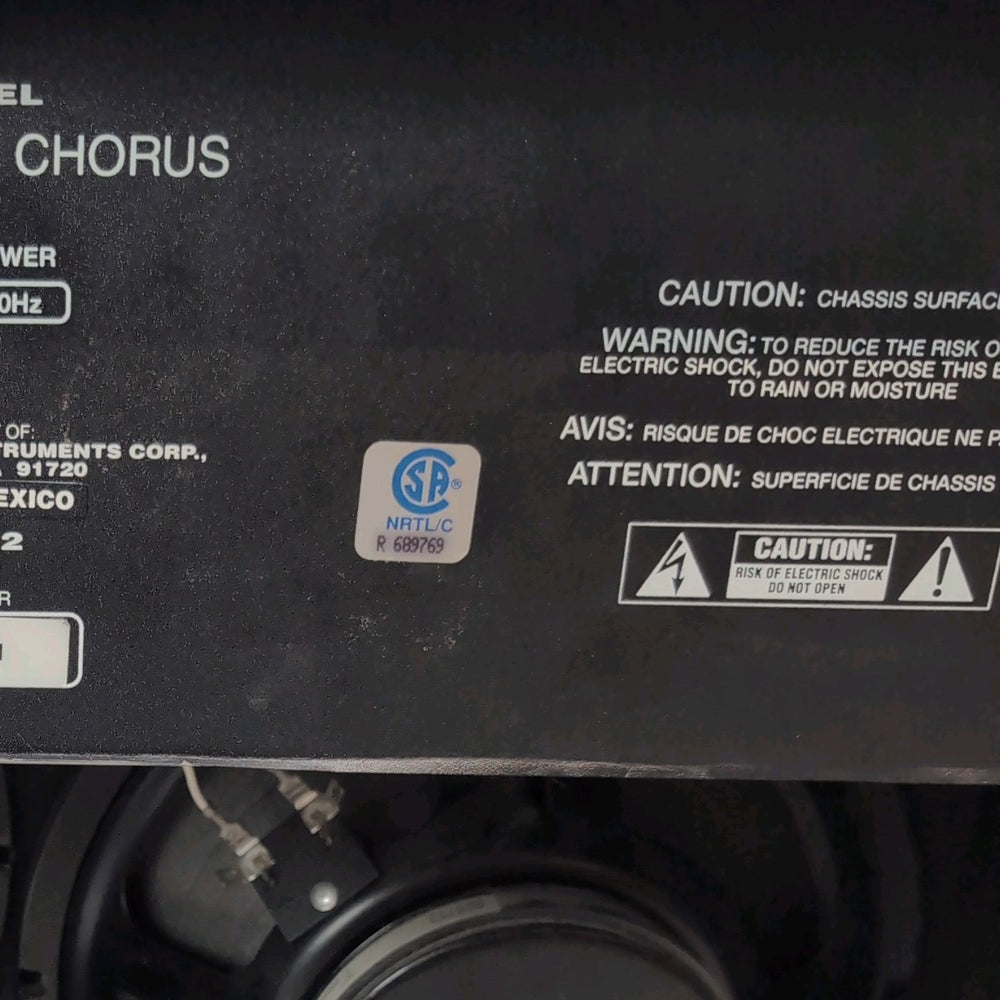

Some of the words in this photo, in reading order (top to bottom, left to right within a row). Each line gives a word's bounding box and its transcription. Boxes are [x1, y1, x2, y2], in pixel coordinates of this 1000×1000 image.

[14, 132, 230, 179] CHORUS
[658, 279, 806, 308] CAUTION:
[817, 289, 909, 309] CHASSIS
[913, 290, 1000, 310] SURFAC
[602, 327, 757, 355] WARNING:
[760, 336, 789, 356] TO
[793, 337, 881, 356] REDUCE
[885, 338, 927, 357] THE
[930, 339, 980, 358] RISK
[579, 355, 679, 376] ELECTRIC
[683, 357, 762, 379] SHOCK,
[768, 358, 800, 377] DO
[804, 358, 850, 378] NOT
[852, 359, 937, 379] EXPOSE
[941, 360, 988, 380] THIS
[727, 378, 756, 398] TO
[760, 379, 810, 398] RAIN
[814, 380, 846, 399] OR
[849, 380, 959, 400] MOISTURE
[5, 424, 36, 440] OF:
[559, 415, 634, 442] AVIS:
[642, 423, 720, 443] RISQUE
[724, 425, 753, 443] DE
[757, 425, 818, 445] CHOC
[821, 426, 951, 447] ELECTRIQUE
[954, 428, 984, 447] NE
[128, 442, 207, 463] CORP.,
[16, 460, 88, 478] 91720
[567, 460, 741, 488] ATTENTION:
[751, 471, 871, 491] SUPERFICIE
[874, 473, 904, 491] DE
[907, 473, 996, 493] CHASSIS
[386, 516, 454, 532] NRTL/C
[376, 535, 386, 553] R
[393, 535, 445, 554] 689769
[754, 536, 874, 561] CAUTION:
[735, 566, 762, 579] RISK
[765, 567, 781, 580] OF
[784, 568, 841, 580] ELECTRIC
[843, 569, 884, 582] SHOCK
[768, 582, 784, 594] DO
[788, 583, 808, 595] NOT
[814, 583, 846, 595] OPEN
